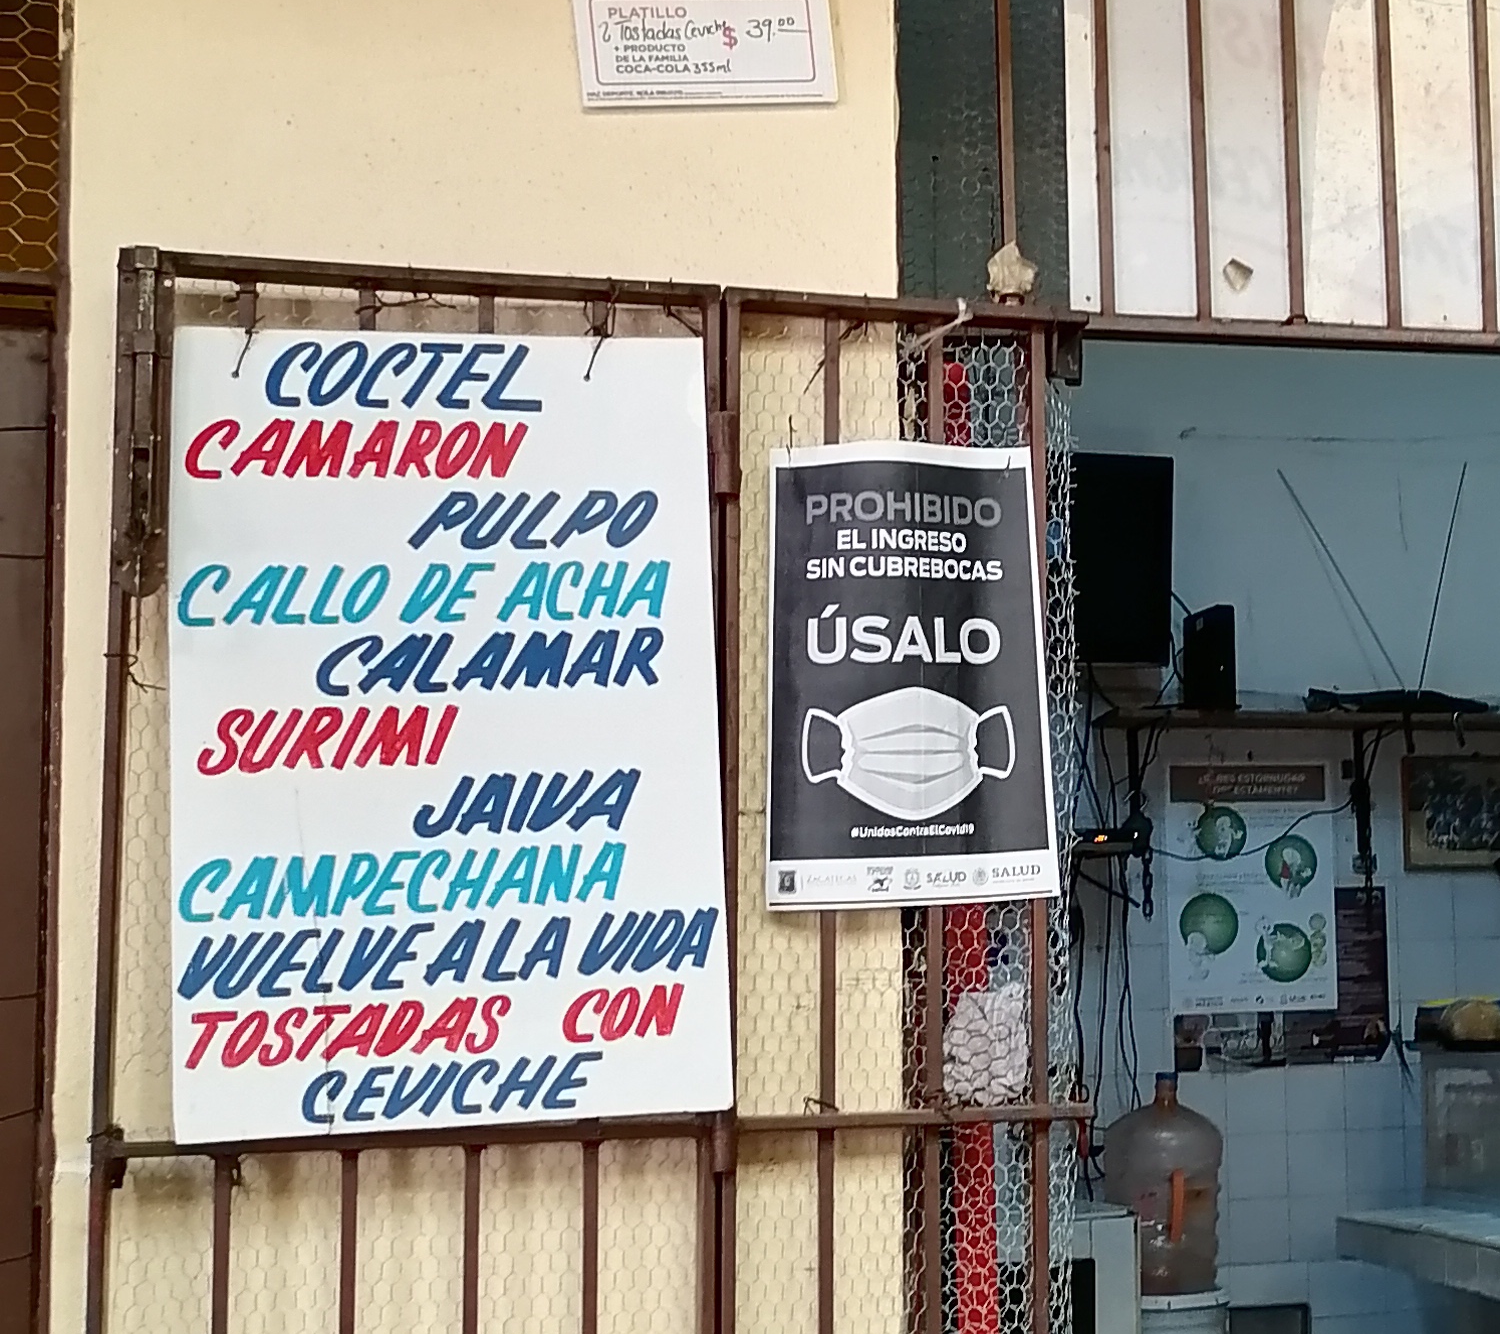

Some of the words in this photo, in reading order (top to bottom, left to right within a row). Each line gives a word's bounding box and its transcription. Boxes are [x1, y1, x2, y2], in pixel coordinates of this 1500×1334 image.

[607, 6, 688, 20] PLATILLO
[722, 25, 738, 50] $
[615, 55, 629, 63] DE
[648, 54, 689, 63] FAMILIA
[615, 64, 691, 75] COCA-COLA
[623, 44, 686, 53] PRODUCTO
[265, 341, 543, 413] COCTEL
[184, 419, 528, 481] CAMARON
[408, 490, 659, 551] PULPO
[806, 491, 1001, 527] PROHIBIDO
[806, 557, 845, 579] SIN
[849, 555, 1003, 581] CUBREBOCAS
[837, 529, 866, 550] EL
[871, 529, 966, 553] INGRESO
[177, 563, 391, 628] CALLO
[400, 562, 496, 623] DE
[497, 560, 671, 621] ACHA
[315, 628, 665, 697] CALAMAR
[806, 603, 1001, 665] ÚSALO
[198, 703, 460, 776] SURIMI
[412, 768, 642, 839] JAIVA
[179, 841, 628, 923] CAMPECHANA
[926, 870, 967, 885] SALUD
[991, 864, 1041, 880] SALUD
[177, 922, 436, 1001] VUELVE
[425, 918, 488, 987] A
[481, 916, 572, 982] LA
[576, 908, 718, 975] VIDA
[185, 994, 512, 1071] TOSTADAS
[562, 982, 686, 1046] CON
[302, 1051, 604, 1126] CEVICHE
